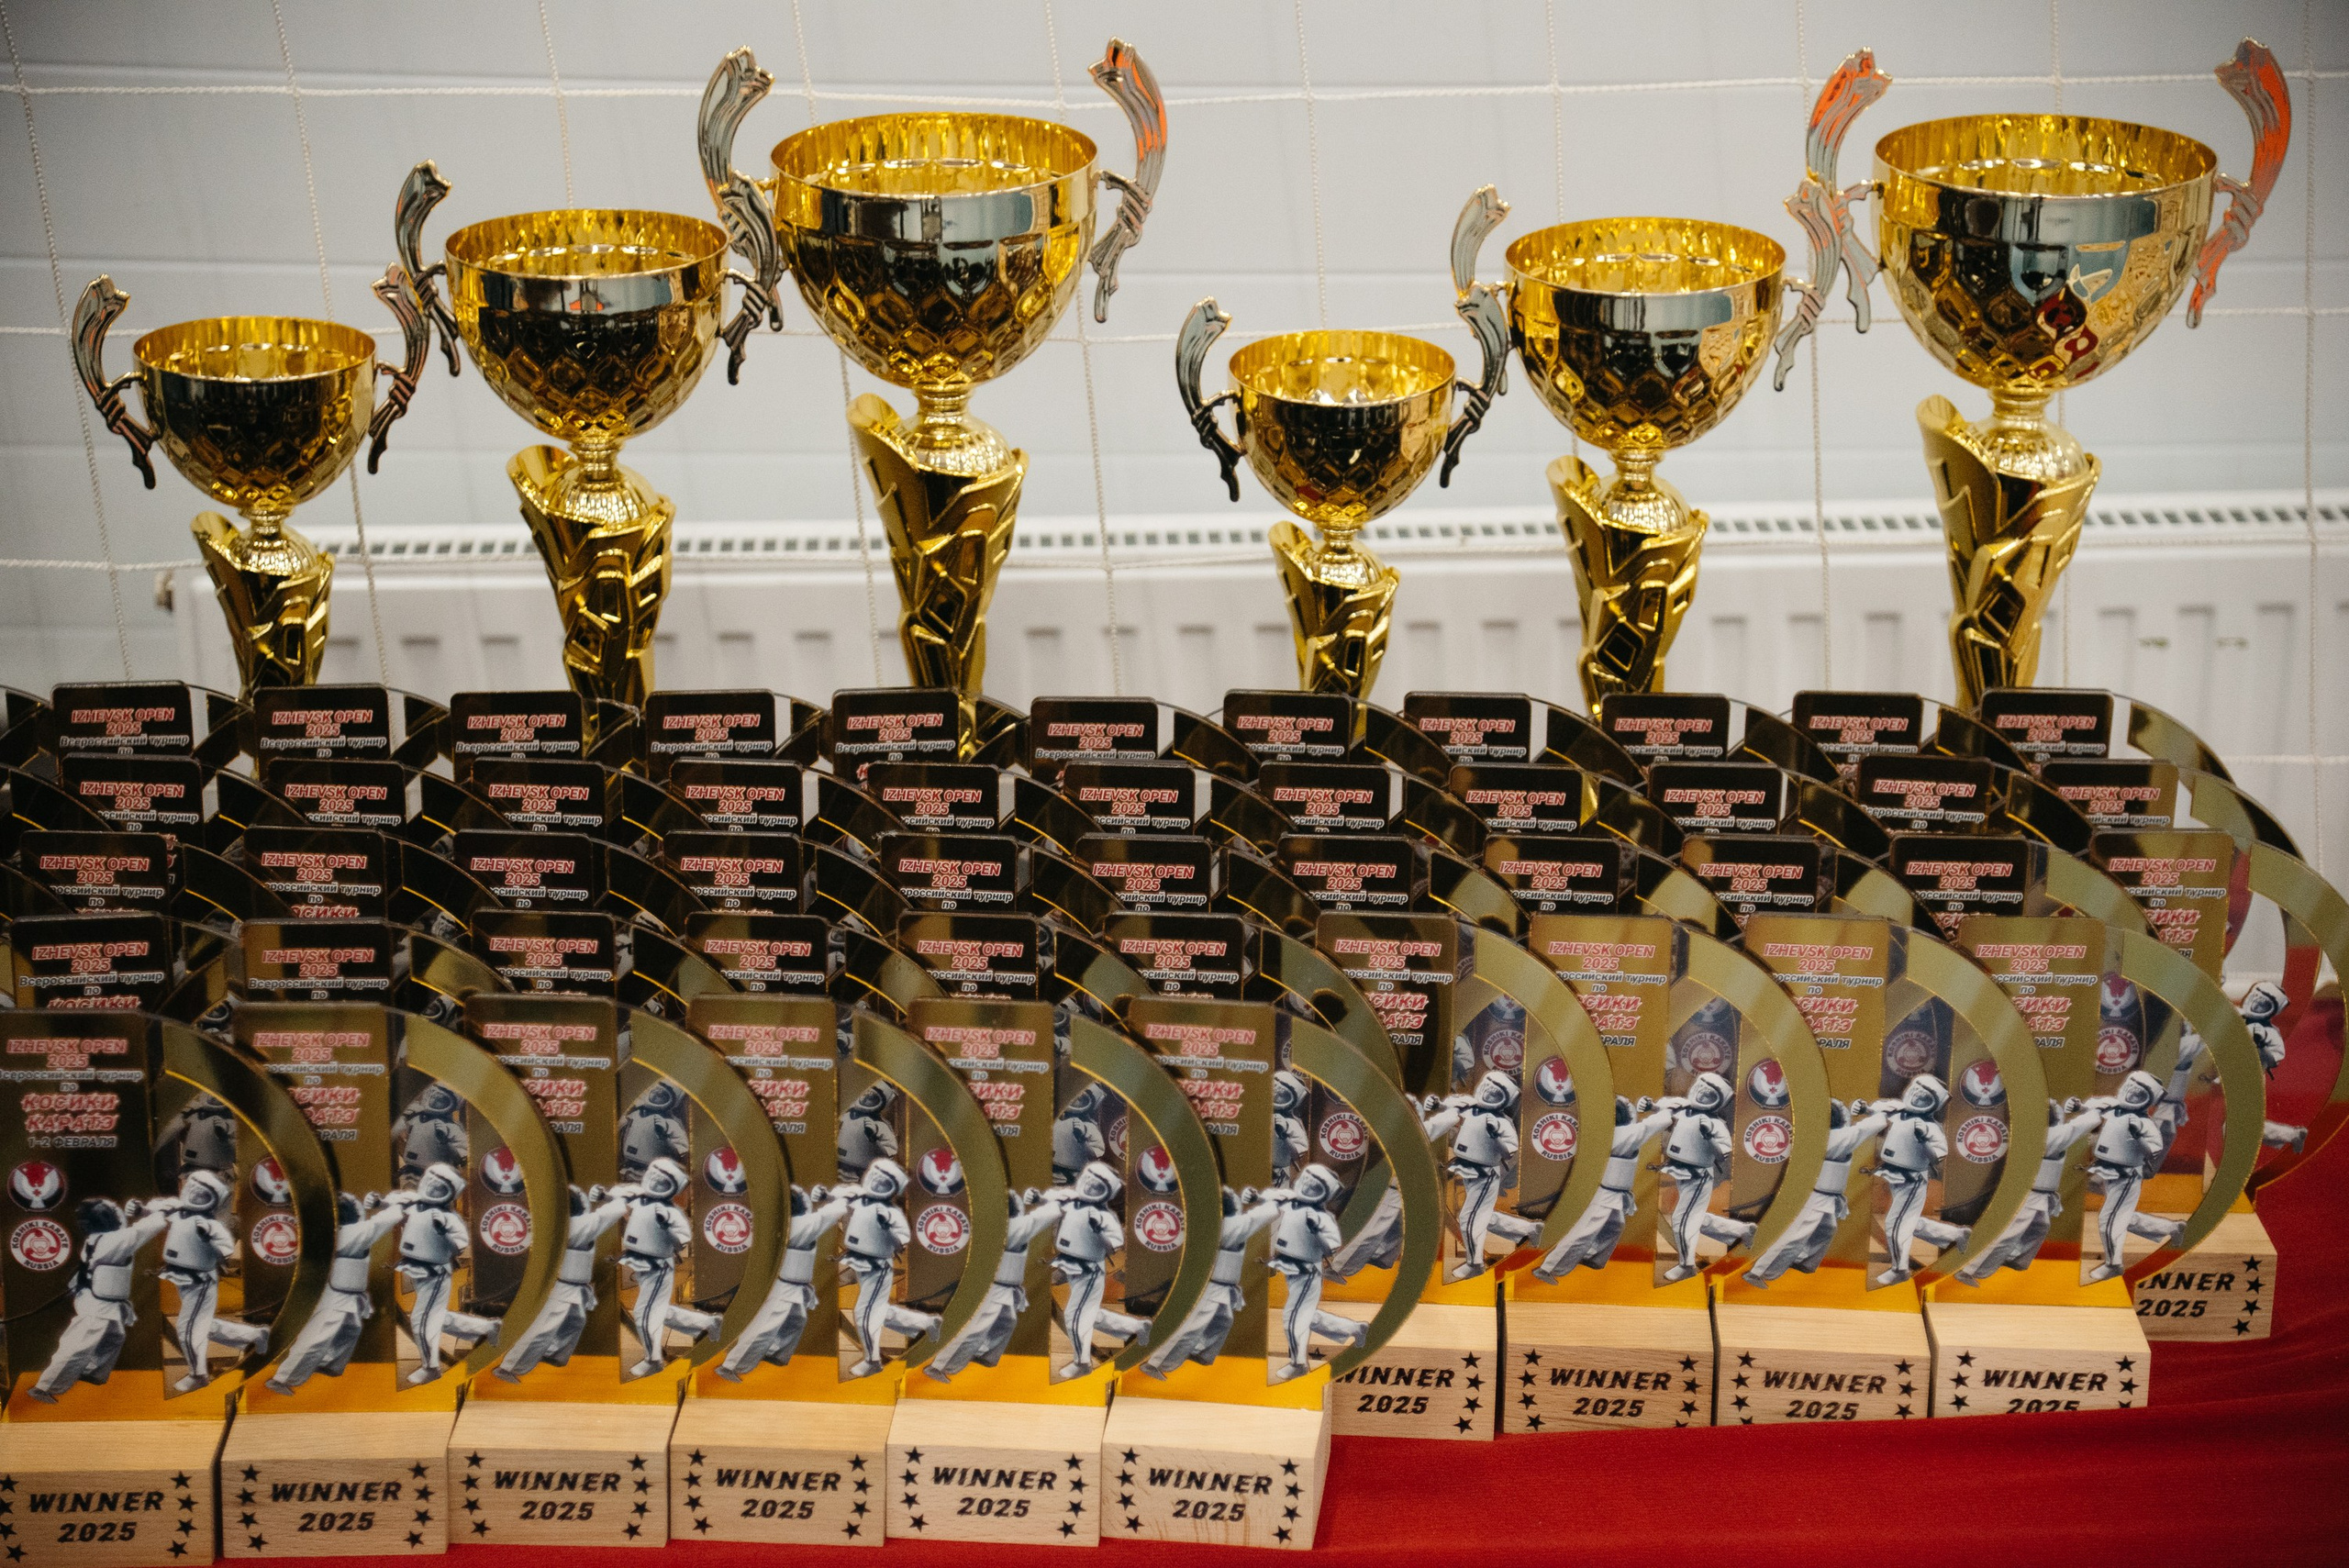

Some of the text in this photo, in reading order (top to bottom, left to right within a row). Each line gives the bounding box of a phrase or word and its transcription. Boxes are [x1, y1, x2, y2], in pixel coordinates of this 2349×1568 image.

[72, 707, 175, 723] IZHEVSK OPEN
[272, 710, 373, 725] IZHEVSK OPEN
[467, 714, 566, 729] IZHEVSK OPEN
[663, 714, 761, 729] IZHEVSK OPEN
[847, 714, 943, 729] IZHEVSK OPEN
[1237, 716, 1333, 730] IZHEVSK OPEN
[1048, 723, 1144, 737] IZHEVSK OPEN
[1419, 718, 1515, 732] IZHEVSK OPEN
[1615, 717, 1712, 732] IZHEVSK OPEN
[1809, 717, 1908, 731] IZHEVSK OPEN
[80, 782, 184, 798] IZHEVSK OPEN
[284, 784, 386, 799] IZHEVSK OPEN
[488, 784, 589, 800] IZHEVSK OPEN
[685, 785, 785, 801] IZHEVSK OPEN
[883, 788, 982, 803] IZHEVSK OPEN
[1079, 788, 1178, 803] IZHEVSK OPEN
[1274, 788, 1373, 804] IZHEVSK OPEN
[1664, 789, 1765, 804] IZHEVSK OPEN
[1873, 780, 1976, 797] IZHEVSK OPEN
[1465, 790, 1565, 806] IZHEVSK OPEN
[39, 855, 150, 872] IZHEVSK OPEN
[261, 852, 366, 869] IZHEVSK OPEN
[470, 857, 574, 873] IZHEVSK OPEN
[680, 857, 784, 873] IZHEVSK OPEN
[898, 860, 1001, 876] IZHEVSK OPEN
[2110, 859, 2216, 873] IZHEVSK OPEN
[1093, 863, 1195, 880] IZHEVSK OPEN
[1294, 863, 1397, 878] IZHEVSK OPEN
[1499, 861, 1602, 877] IZHEVSK OPEN
[1698, 863, 1804, 879] IZHEVSK OPEN
[1906, 862, 2012, 877] IZHEVSK OPEN
[32, 942, 149, 960] IZHEVSK OPEN
[489, 938, 598, 954] IZHEVSK OPEN
[704, 940, 812, 956] IZHEVSK OPEN
[917, 940, 1023, 958] IZHEVSK OPEN
[1120, 940, 1226, 956] IZHEVSK OPEN
[1335, 940, 1442, 956] IZHEVSK OPEN
[1548, 942, 1655, 958] IZHEVSK OPEN
[1764, 943, 1873, 960] IZHEVSK OPEN
[1976, 945, 2087, 959] IZHEVSK OPEN
[262, 949, 374, 963] IZHEVSK OPEN
[1369, 955, 1406, 969] 2025
[1582, 957, 1620, 971] 2025
[1798, 959, 1836, 973] 2025
[2010, 959, 2049, 973] 2025
[19, 972, 163, 987] Всероссийский турнир
[249, 978, 388, 990] Всероссийский турнир
[252, 1033, 370, 1047] IZHEVSK OPEN
[484, 1024, 597, 1040] IZHEVSK OPEN
[708, 1025, 819, 1041] IZHEVSK OPEN
[925, 1027, 1036, 1045] IZHEVSK OPEN
[1145, 1023, 1256, 1043] IZHEVSK OPEN
[6, 1039, 127, 1054] IZHEVSK OPEN
[520, 1040, 560, 1054] 2025
[744, 1040, 783, 1055] 2025
[961, 1043, 999, 1058] 2025
[1180, 1040, 1219, 1055] 2025
[46, 1054, 89, 1068] 2025
[292, 1048, 333, 1062] 2025
[95, 1069, 144, 1082] турнир
[60, 1081, 80, 1092] по
[21, 1094, 119, 1110] КОСИКИ
[25, 1113, 119, 1133] КАРАТЭ
[1958, 1118, 2009, 1143] KOSHIKI KARATE
[53, 1135, 117, 1148] ФЕВРАЛЯ
[1966, 1152, 1998, 1163] RUSSIA
[918, 1206, 970, 1234] KOSHIKI KARATE
[1136, 1204, 1162, 1229] KOSHIKI
[12, 1220, 69, 1250] KOSHIKI KARATE
[927, 1243, 961, 1254] RUSSIA
[1145, 1240, 1178, 1251] RUSSIA
[24, 1259, 59, 1270] RUSSIA
[2138, 1272, 2235, 1293] NNER
[2137, 1298, 2208, 1318] 2025
[1549, 1368, 1672, 1391] WINNER
[1764, 1370, 1887, 1395] WINNER
[1983, 1369, 2109, 1393] WINNER
[1357, 1395, 1429, 1415] 2025
[1573, 1397, 1644, 1418] 2025
[1787, 1399, 1859, 1420] 2025
[2007, 1398, 2081, 1413] 2025
[494, 1470, 621, 1493] WINNER
[717, 1469, 841, 1493] WINNER
[932, 1467, 1058, 1490] WINNER
[1148, 1469, 1274, 1496] WINNER
[271, 1481, 402, 1503] WINNER
[29, 1490, 165, 1513] WINNER
[740, 1499, 815, 1519] 2025
[957, 1497, 1031, 1518] 2025
[519, 1501, 595, 1521] 2025
[1173, 1499, 1246, 1521] 2025
[298, 1511, 375, 1532] 2025
[58, 1522, 137, 1543] 2025
